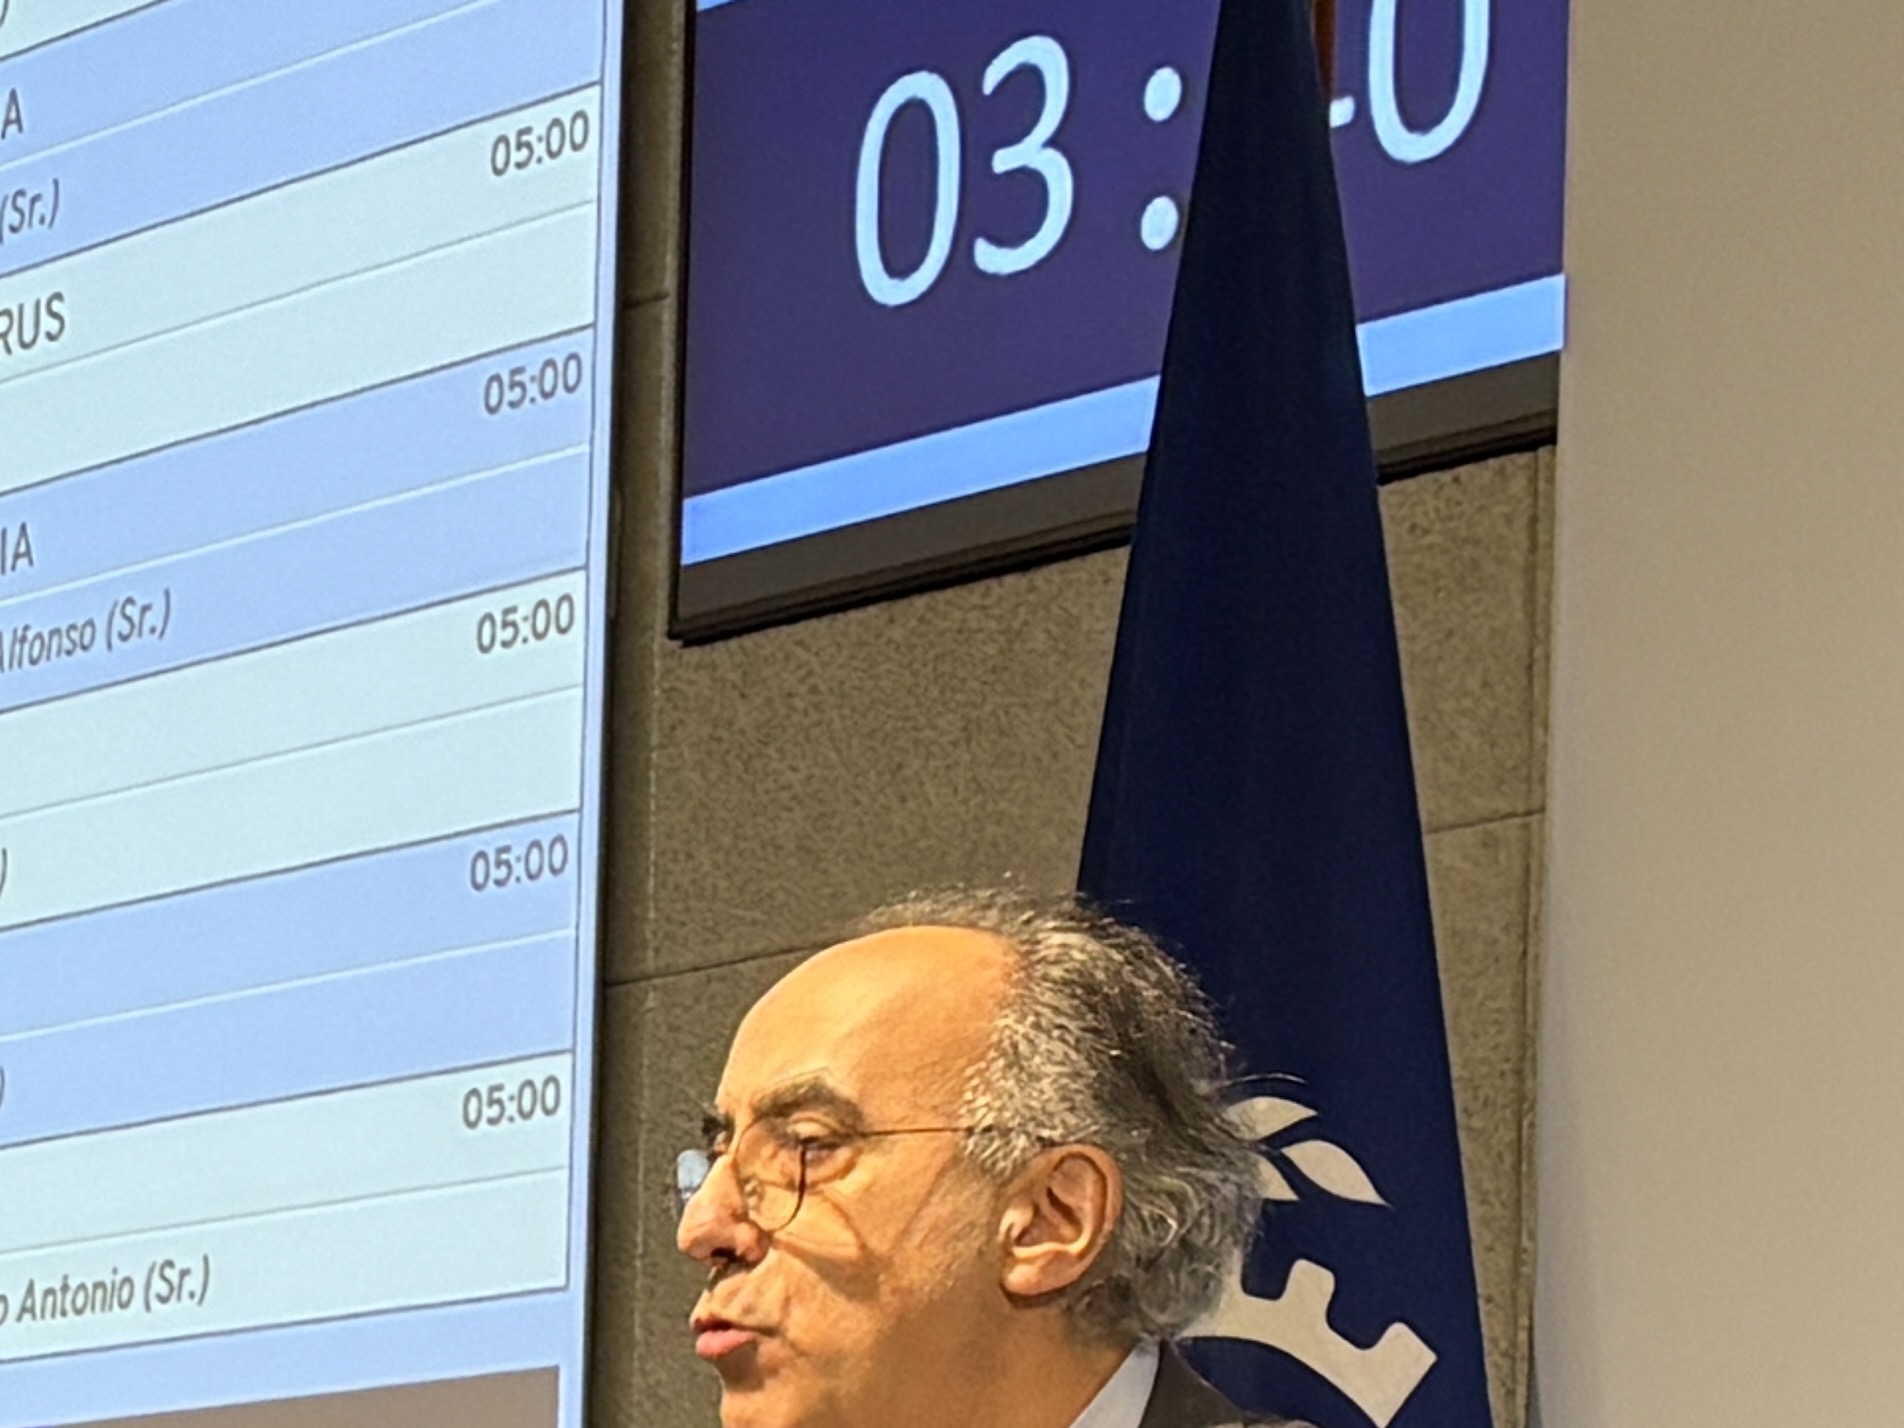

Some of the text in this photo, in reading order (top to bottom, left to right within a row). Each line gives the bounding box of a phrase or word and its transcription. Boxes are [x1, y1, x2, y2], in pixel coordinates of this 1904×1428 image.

[490, 109, 589, 177] 05:00
[855, 0, 1490, 306] 03:0
[483, 352, 582, 415] 05:00
[104, 588, 171, 651] (Sr.)
[476, 593, 575, 655] 05:00
[469, 834, 568, 892] 05:00
[462, 1074, 561, 1130] 05:00
[17, 1265, 133, 1322] Antonio
[143, 1254, 210, 1313] (Sr.)
